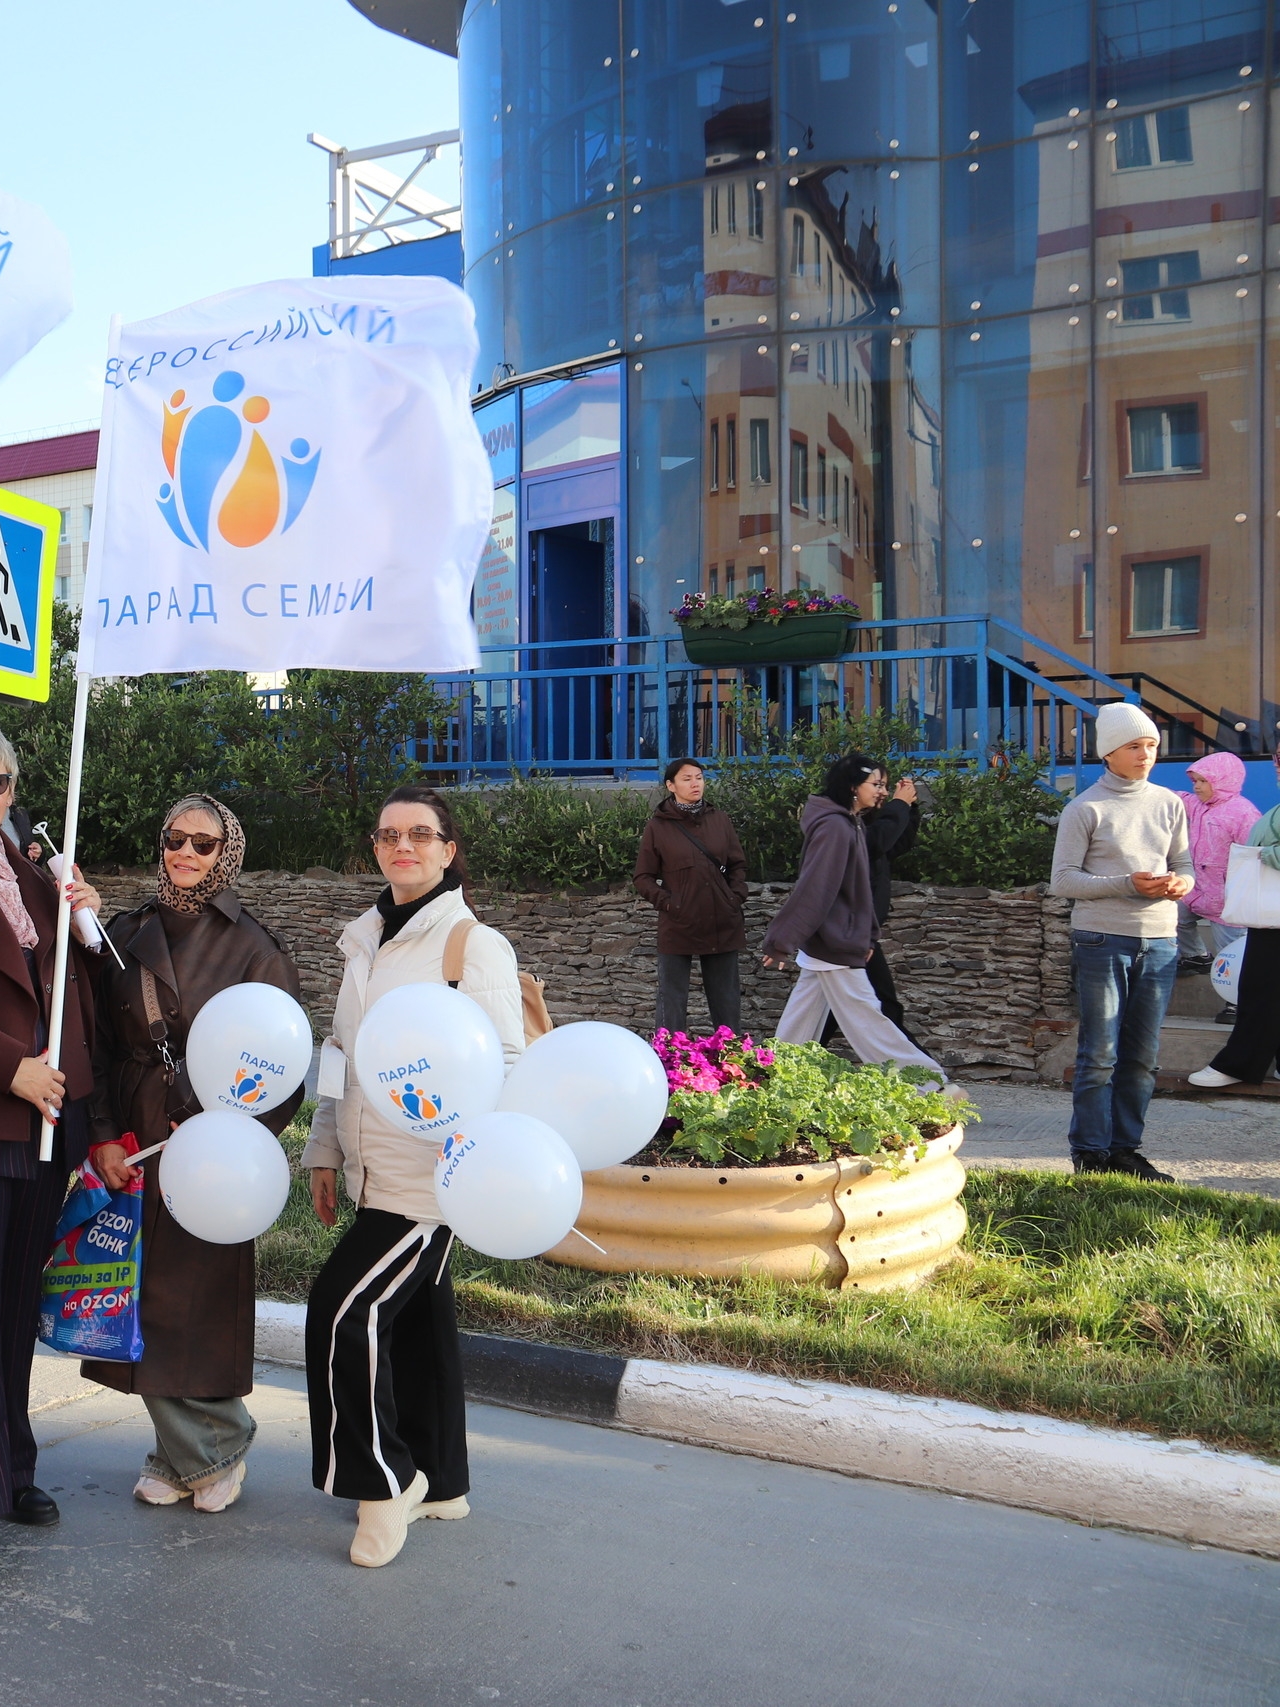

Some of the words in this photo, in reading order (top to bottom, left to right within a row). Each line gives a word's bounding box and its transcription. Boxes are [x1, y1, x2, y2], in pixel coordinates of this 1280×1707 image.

[241, 576, 374, 618] СЕМЬИ
[240, 1051, 286, 1076] ПАРАД
[378, 1058, 431, 1083] ПАРАД
[218, 1095, 260, 1112] СЕМЬИ
[411, 1112, 461, 1132] СЕМЬИ
[442, 1139, 476, 1189] ПАРАД
[87, 1225, 128, 1256] банк
[43, 1272, 92, 1288] товары
[95, 1271, 112, 1283] за
[64, 1301, 77, 1311] на
[80, 1292, 129, 1310] OZON
